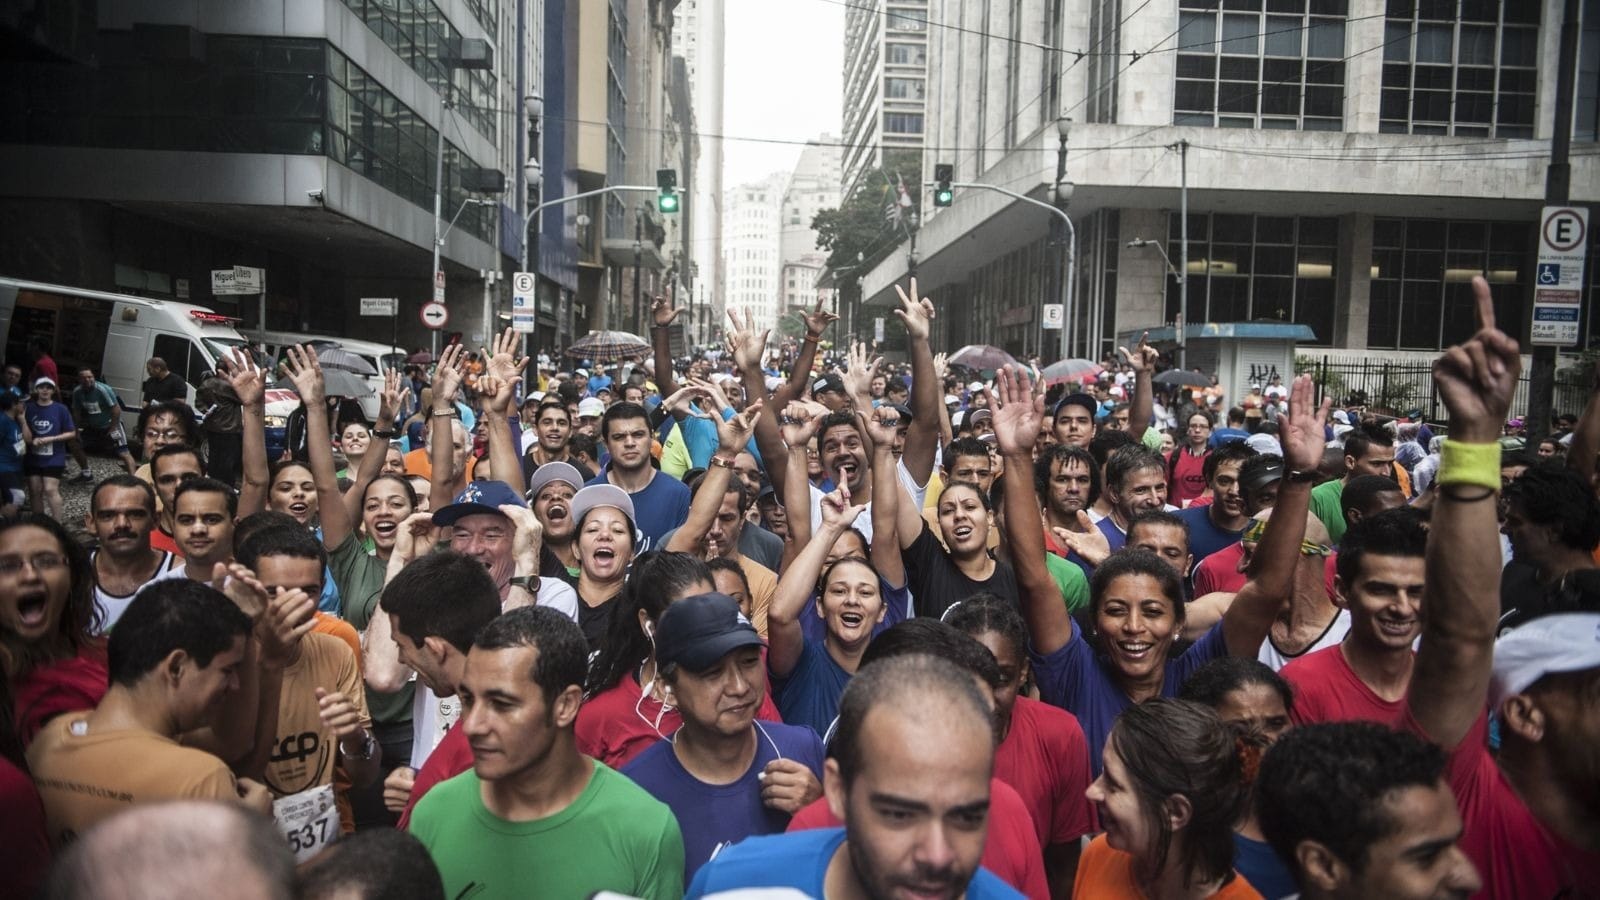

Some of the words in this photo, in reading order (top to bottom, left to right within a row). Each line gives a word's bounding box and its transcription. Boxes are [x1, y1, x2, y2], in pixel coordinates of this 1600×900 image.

[1556, 218, 1573, 243] E
[214, 271, 235, 284] Miguel
[521, 277, 528, 289] E
[1050, 308, 1057, 319] E
